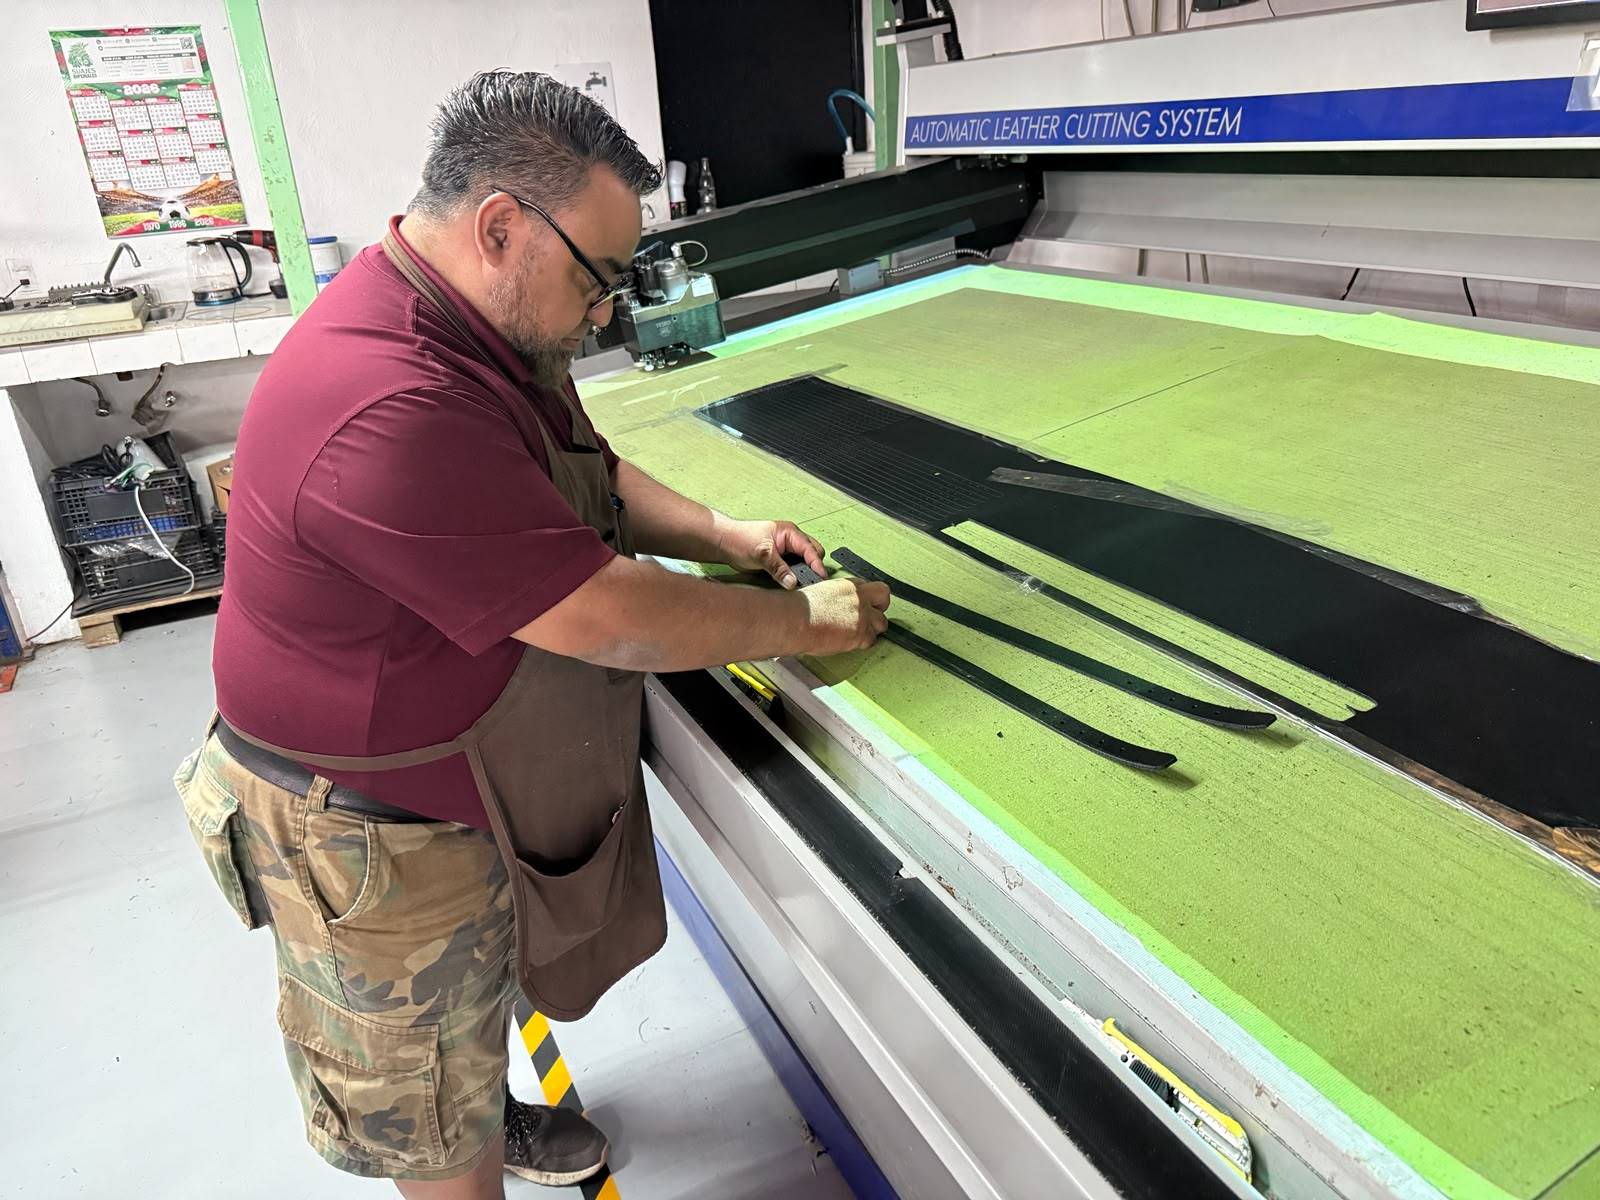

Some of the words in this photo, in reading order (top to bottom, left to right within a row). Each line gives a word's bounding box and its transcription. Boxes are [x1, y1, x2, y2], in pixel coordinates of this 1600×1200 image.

[123, 83, 160, 96] 2026
[910, 117, 991, 143] AUTOMATIC
[993, 113, 1060, 141] LEATHER
[1064, 110, 1152, 140] CUTTING
[1155, 106, 1243, 138] SYSTEM
[142, 221, 161, 231] 1970
[194, 217, 214, 227] 2026
